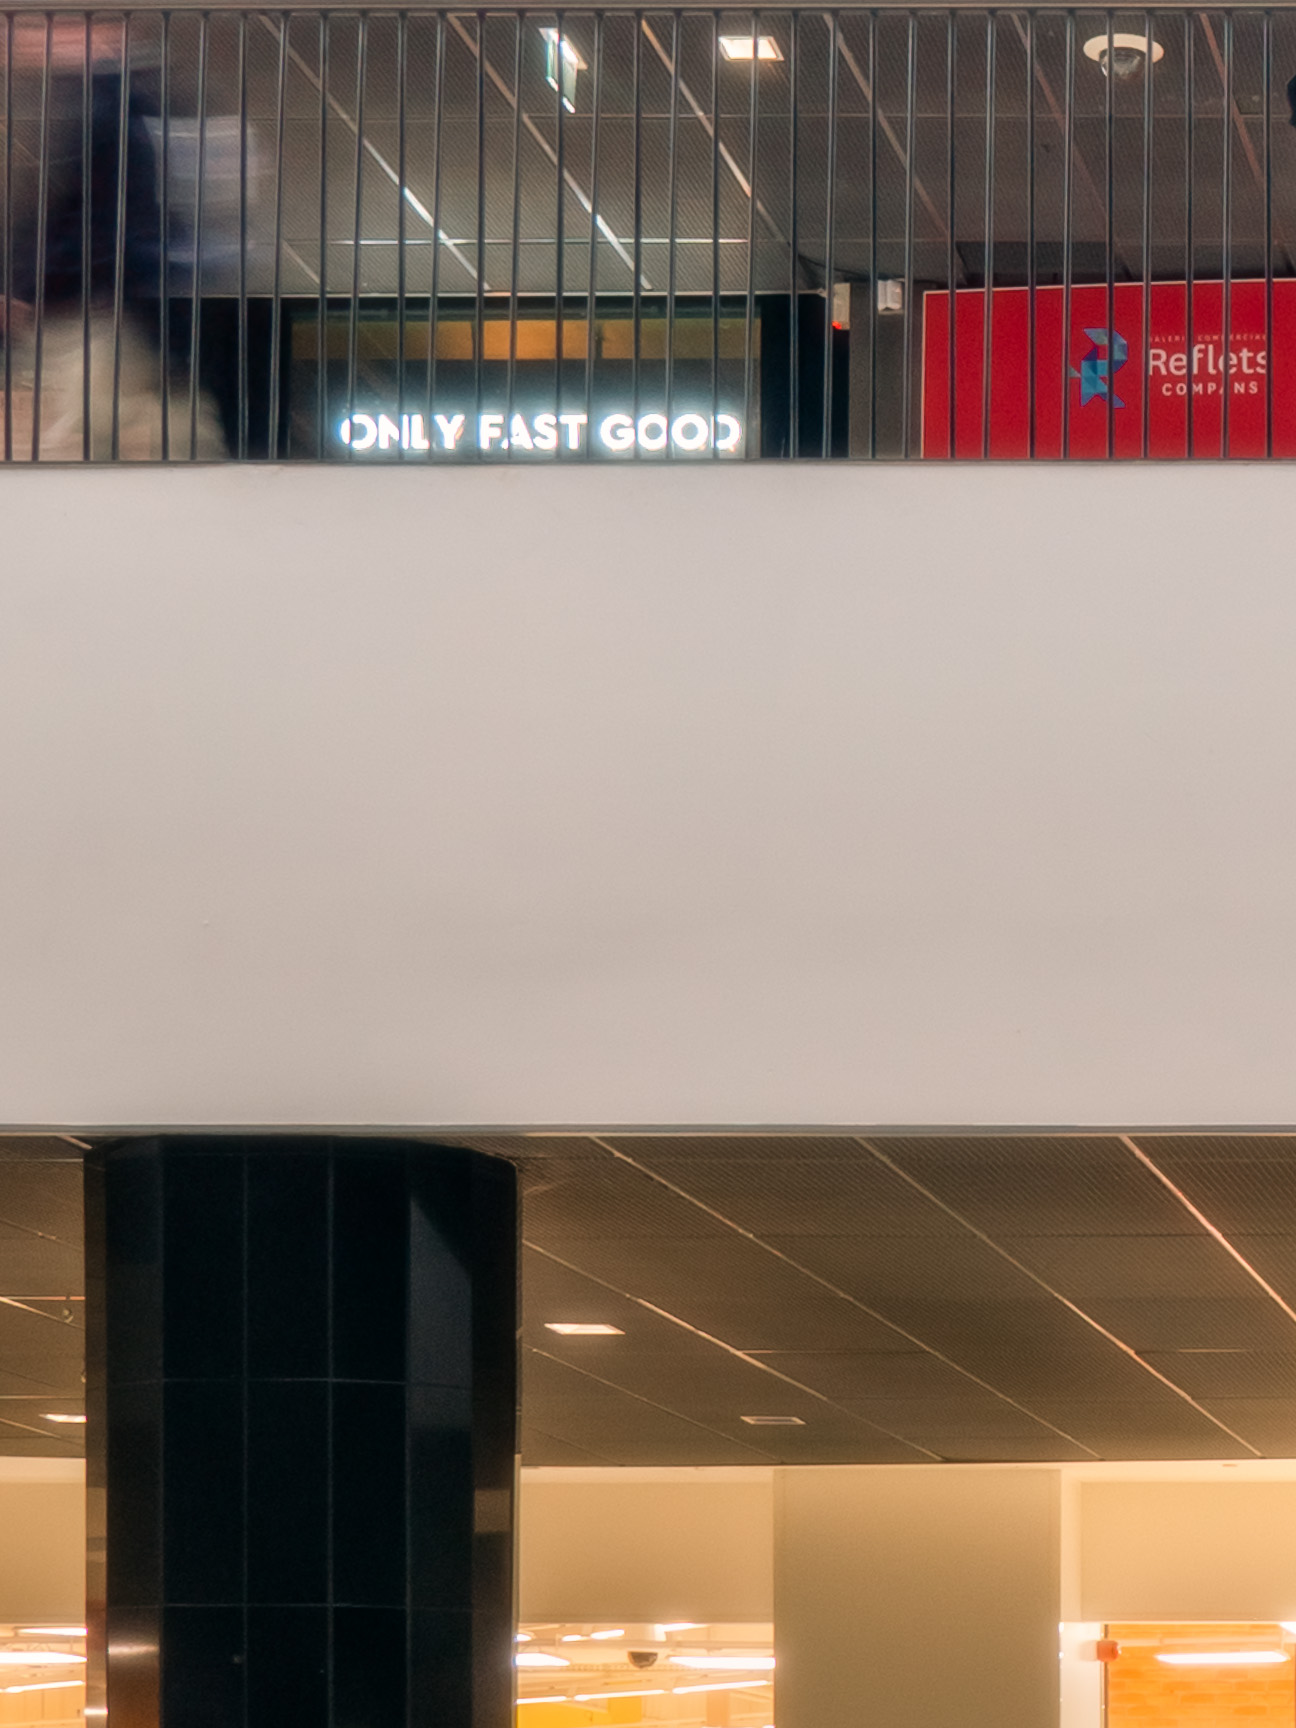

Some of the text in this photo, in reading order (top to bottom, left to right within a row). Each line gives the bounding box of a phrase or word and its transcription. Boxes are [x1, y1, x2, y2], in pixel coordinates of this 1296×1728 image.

[1149, 343, 1267, 376] Reflets
[1161, 381, 1259, 396] COMPNS
[339, 413, 742, 450] ONLY FAST GOOD
